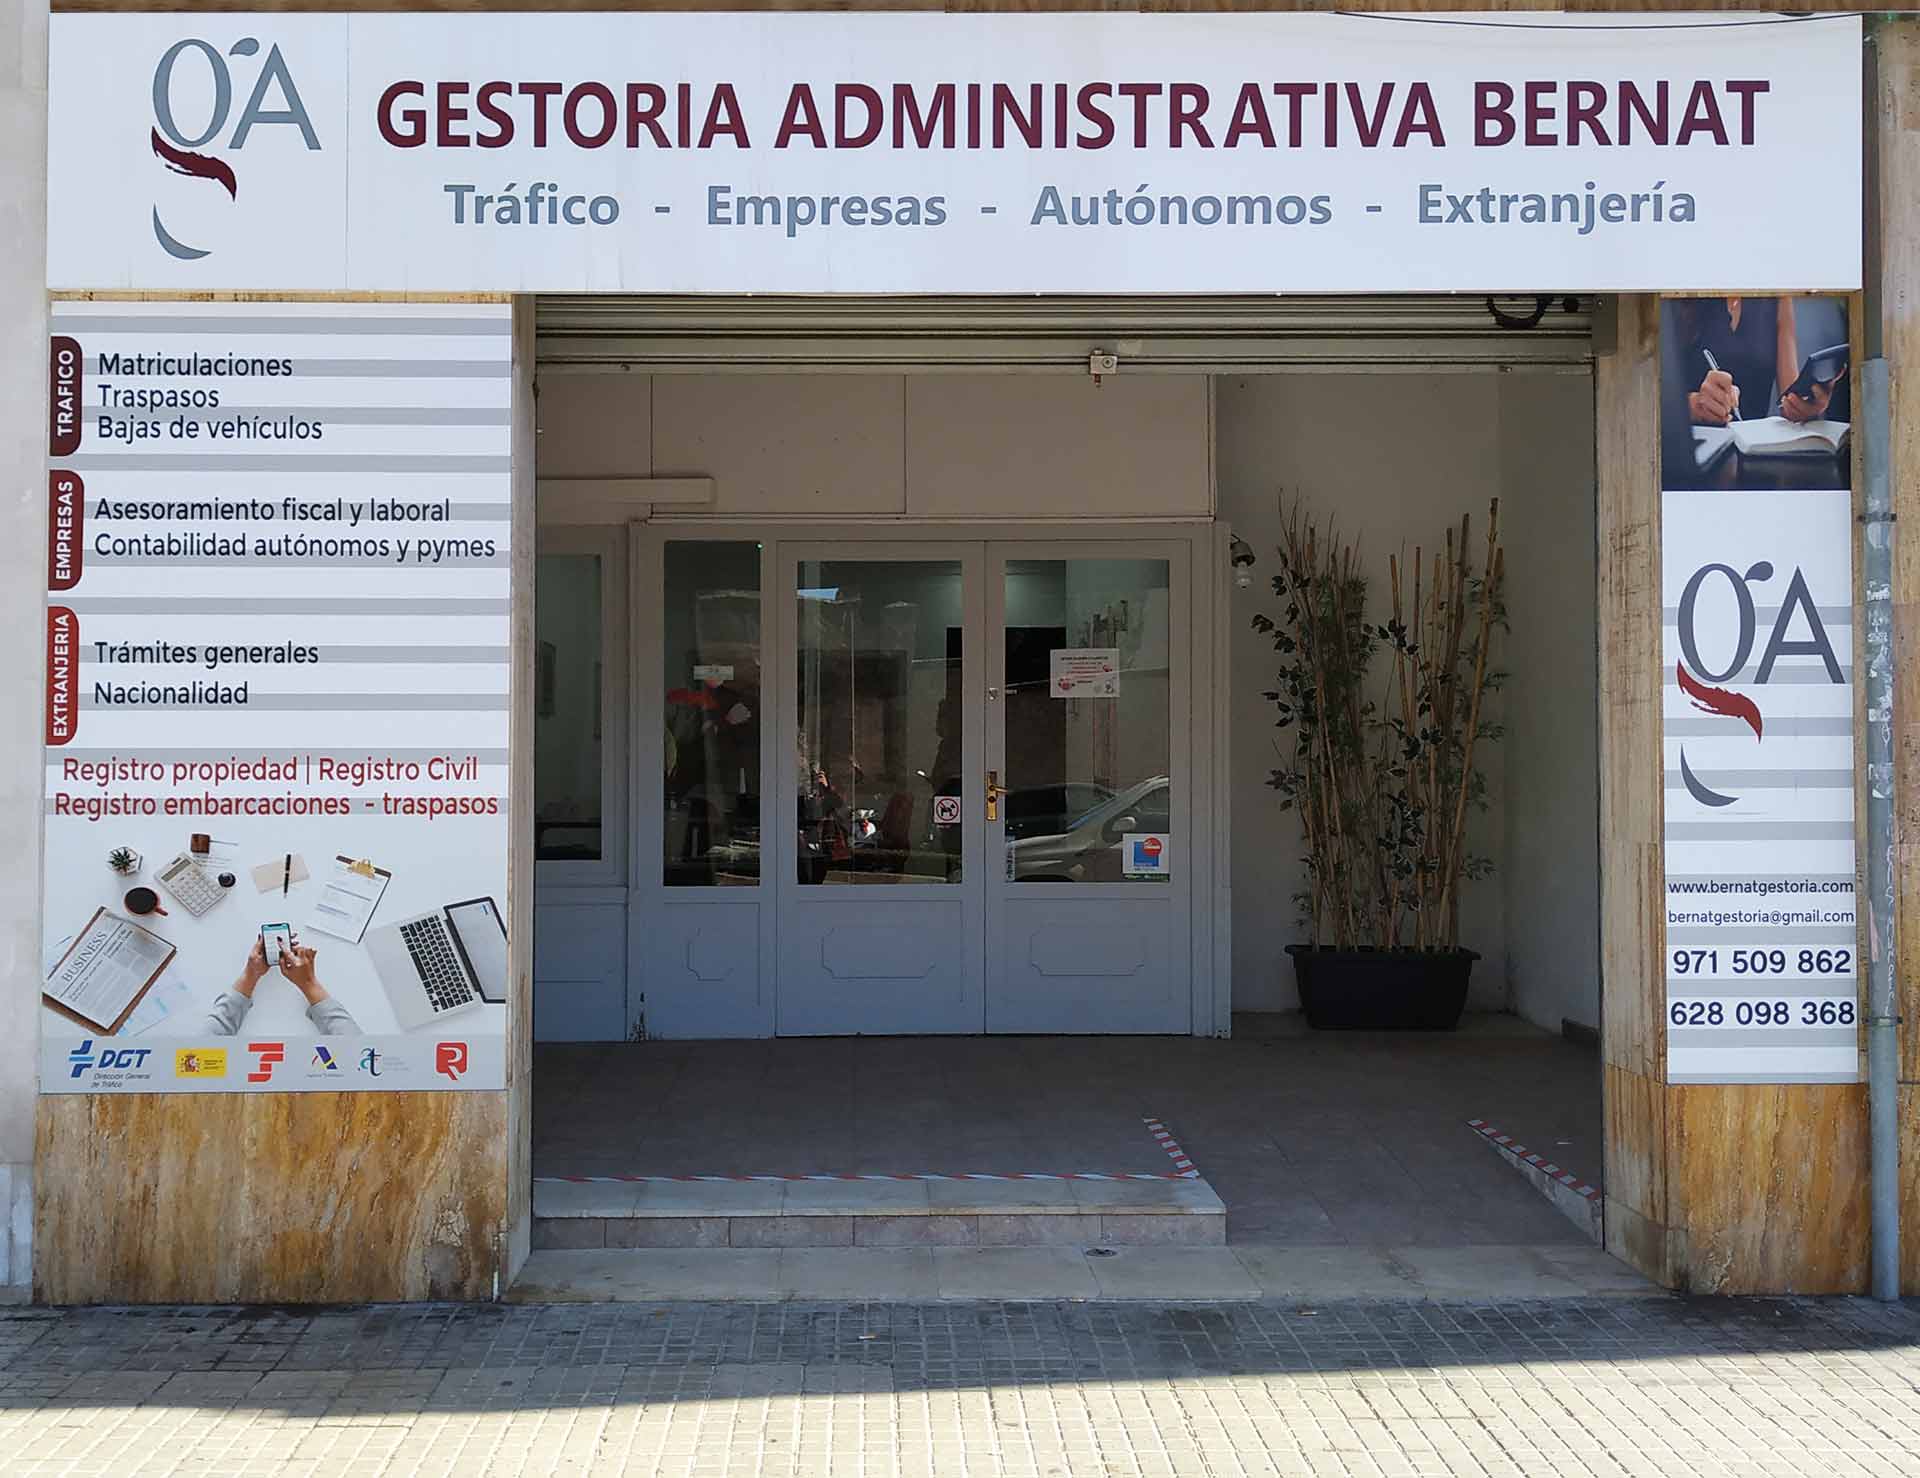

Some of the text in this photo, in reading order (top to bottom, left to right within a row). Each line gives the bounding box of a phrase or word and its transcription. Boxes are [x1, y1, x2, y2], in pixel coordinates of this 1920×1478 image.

[377, 80, 1770, 150] GESTORIA ADMINISTRATIVA BERNAT
[444, 183, 620, 226] Tráfico
[709, 184, 947, 238] Empresas
[1030, 184, 1332, 226] Autónomos
[1419, 181, 1696, 236] Extranjería
[98, 353, 293, 377] Matriculaciones
[56, 350, 74, 437] TRAFICO
[98, 384, 220, 413] Traspasos
[98, 416, 323, 445] Bajas de vehículos
[95, 498, 450, 528] Asesoramiento fiscal y laboral
[55, 480, 73, 581] EMPRESAS
[95, 533, 496, 563] Contabilidad autónomos y pymes
[94, 640, 319, 669] Trámites generales
[52, 613, 70, 738] EXTRANJERIA
[94, 681, 249, 705] Nacionalidad
[63, 757, 165, 787] Registro
[172, 757, 298, 786] propiedad
[319, 757, 420, 787] Registro
[427, 757, 478, 780] Civil
[54, 793, 156, 822] Registro
[164, 792, 350, 816] embarcaciones
[383, 793, 498, 819] traspasos
[1668, 879, 1854, 896] www.bernatgestoria.com
[1668, 910, 1854, 926] bernatgestoria@gmail.com
[61, 930, 107, 984] BUSINESS
[1673, 950, 1851, 974] 971 509 862
[1670, 1001, 1855, 1026] 628 098 368
[98, 1049, 152, 1069] DGT
